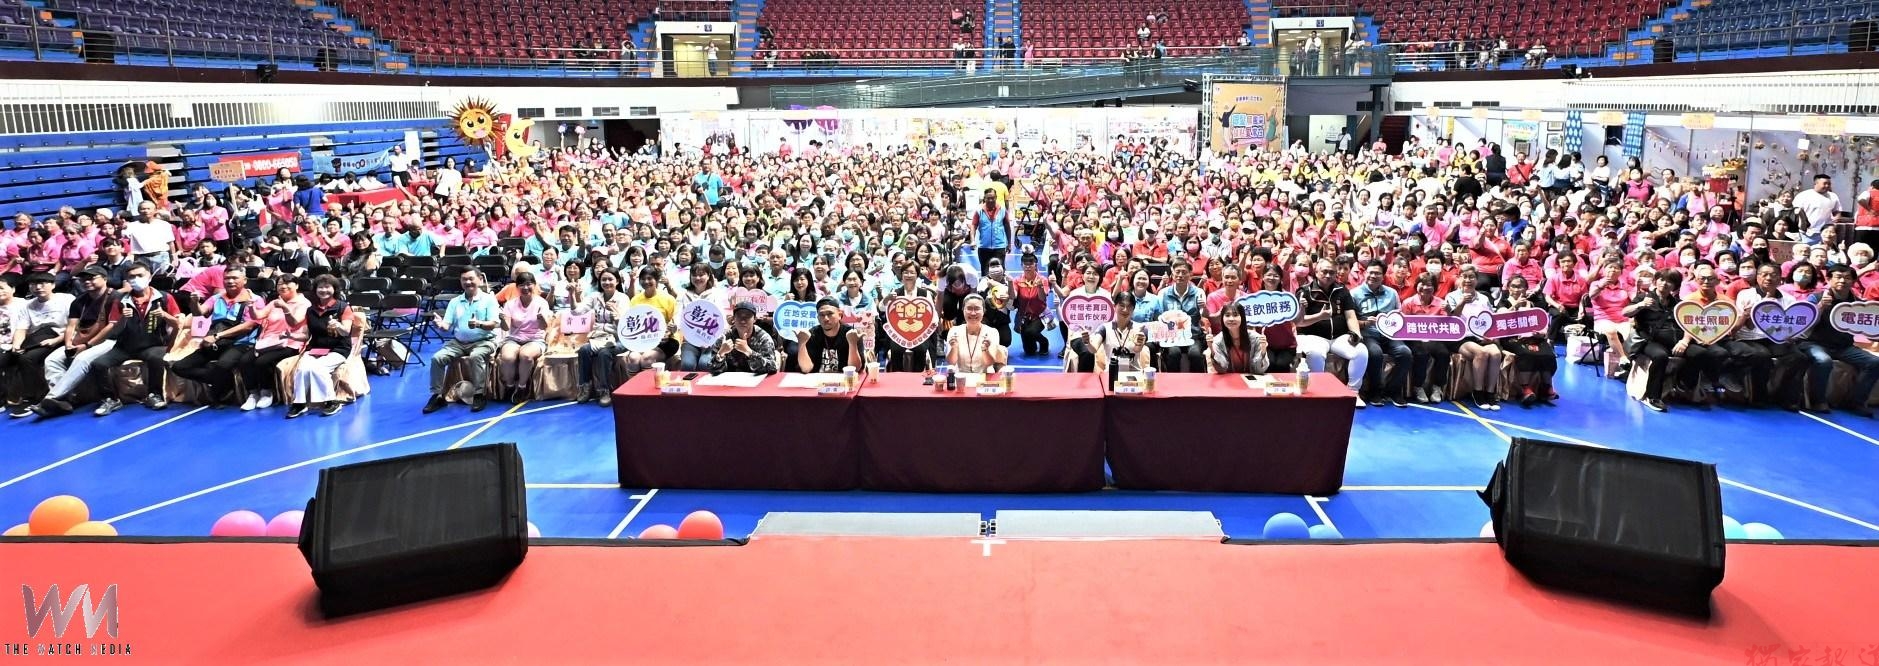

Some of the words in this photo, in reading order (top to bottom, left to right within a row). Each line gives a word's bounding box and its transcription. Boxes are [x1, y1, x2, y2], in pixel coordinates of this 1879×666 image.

[1496, 315, 1539, 331] 獨老關懷
[1760, 314, 1807, 325] 共生社區
[1406, 322, 1460, 334] 跨世代共融
